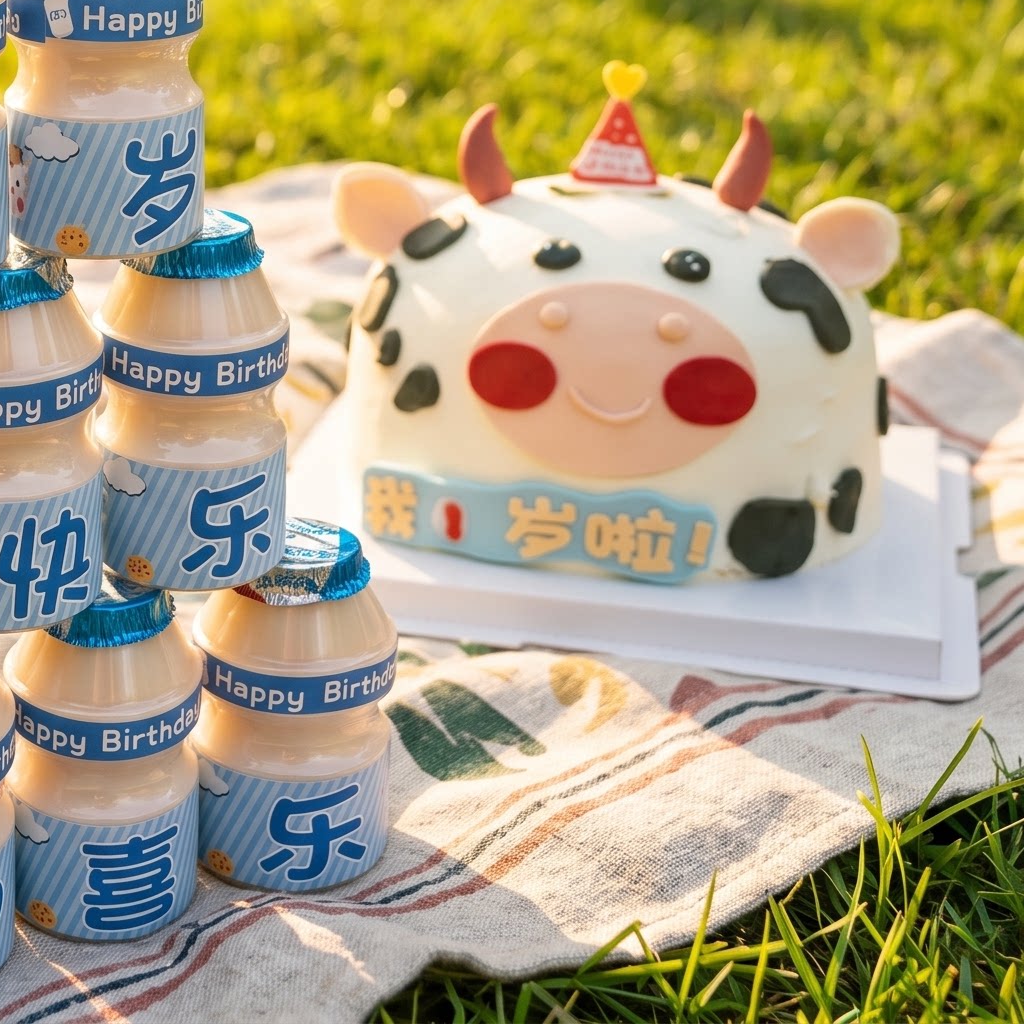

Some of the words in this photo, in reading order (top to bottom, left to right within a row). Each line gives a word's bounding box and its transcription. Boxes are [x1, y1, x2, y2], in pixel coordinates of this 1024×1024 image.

[83, 5, 177, 38] Happy
[121, 128, 197, 247] 岁
[112, 346, 201, 394] Happy
[179, 473, 273, 579] 乐
[215, 665, 304, 712] Happy
[258, 783, 367, 881] 乐
